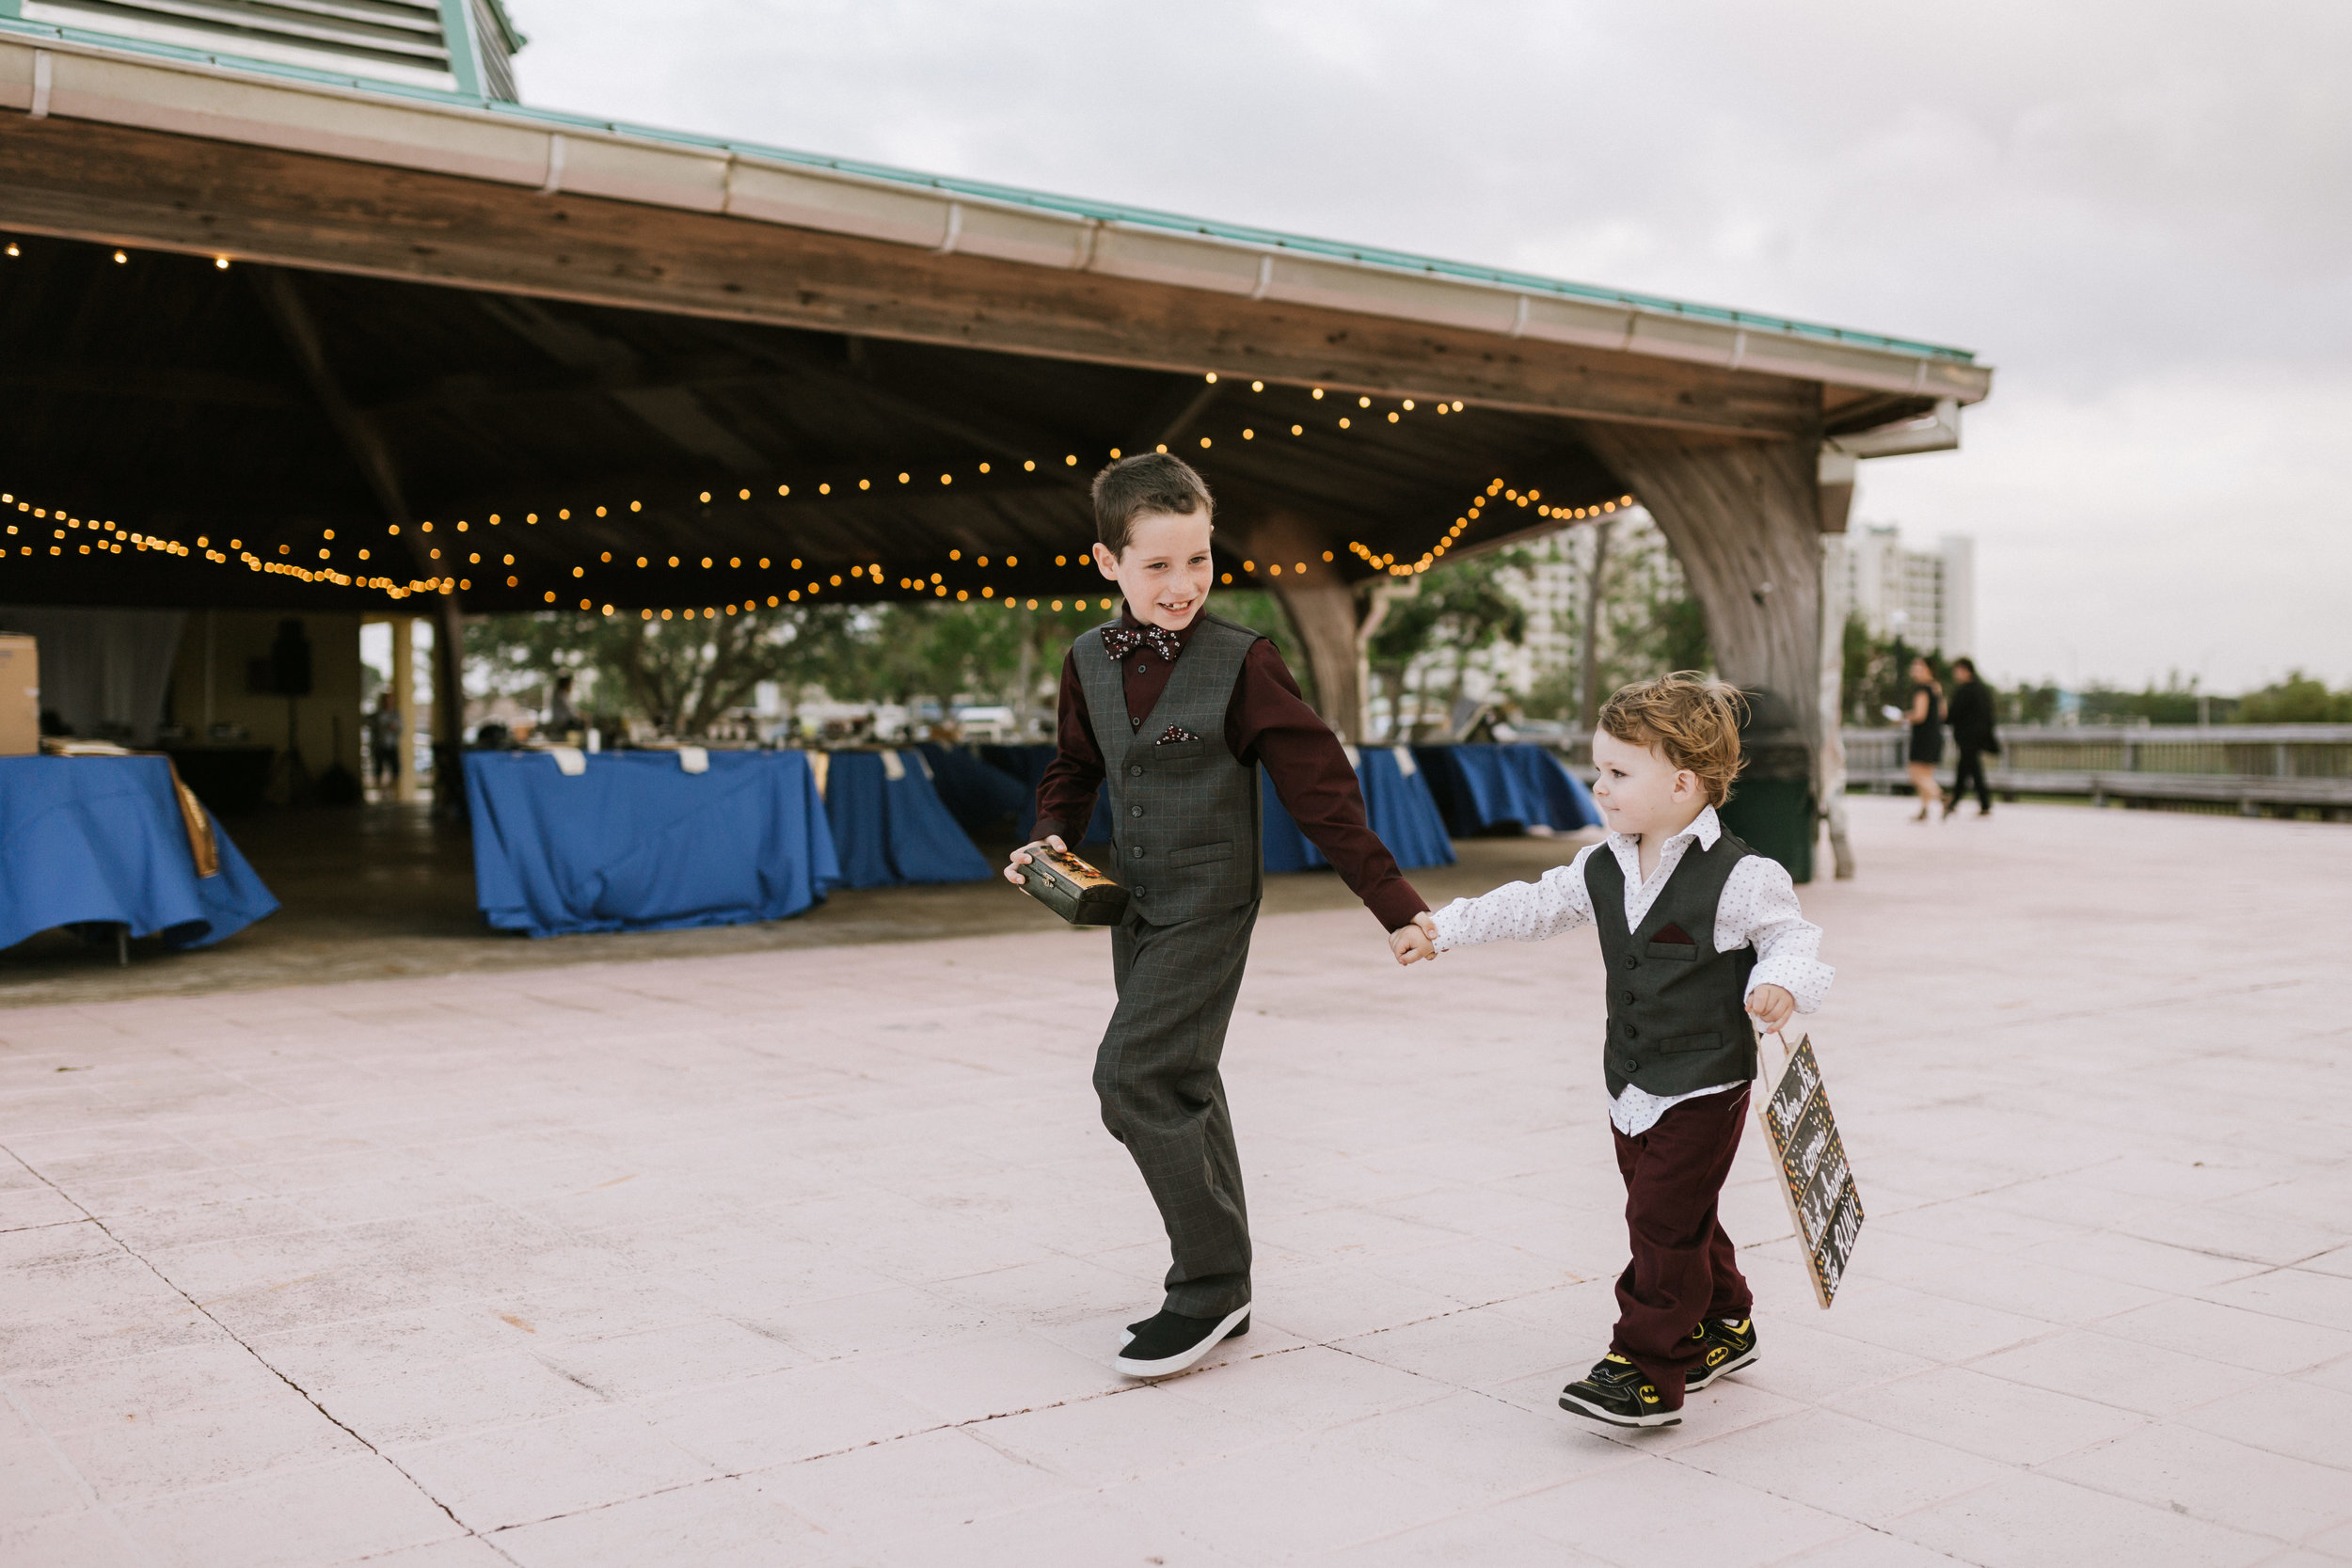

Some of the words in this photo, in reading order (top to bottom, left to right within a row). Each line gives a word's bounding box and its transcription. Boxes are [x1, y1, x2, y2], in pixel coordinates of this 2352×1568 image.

[1774, 1091, 1803, 1140] Here
[1798, 1060, 1817, 1107] she
[1802, 1130, 1826, 1178] comes
[1802, 1190, 1826, 1251] last
[1823, 1157, 1848, 1211] chance
[1820, 1247, 1840, 1294] to
[1834, 1194, 1861, 1266] RUN!
